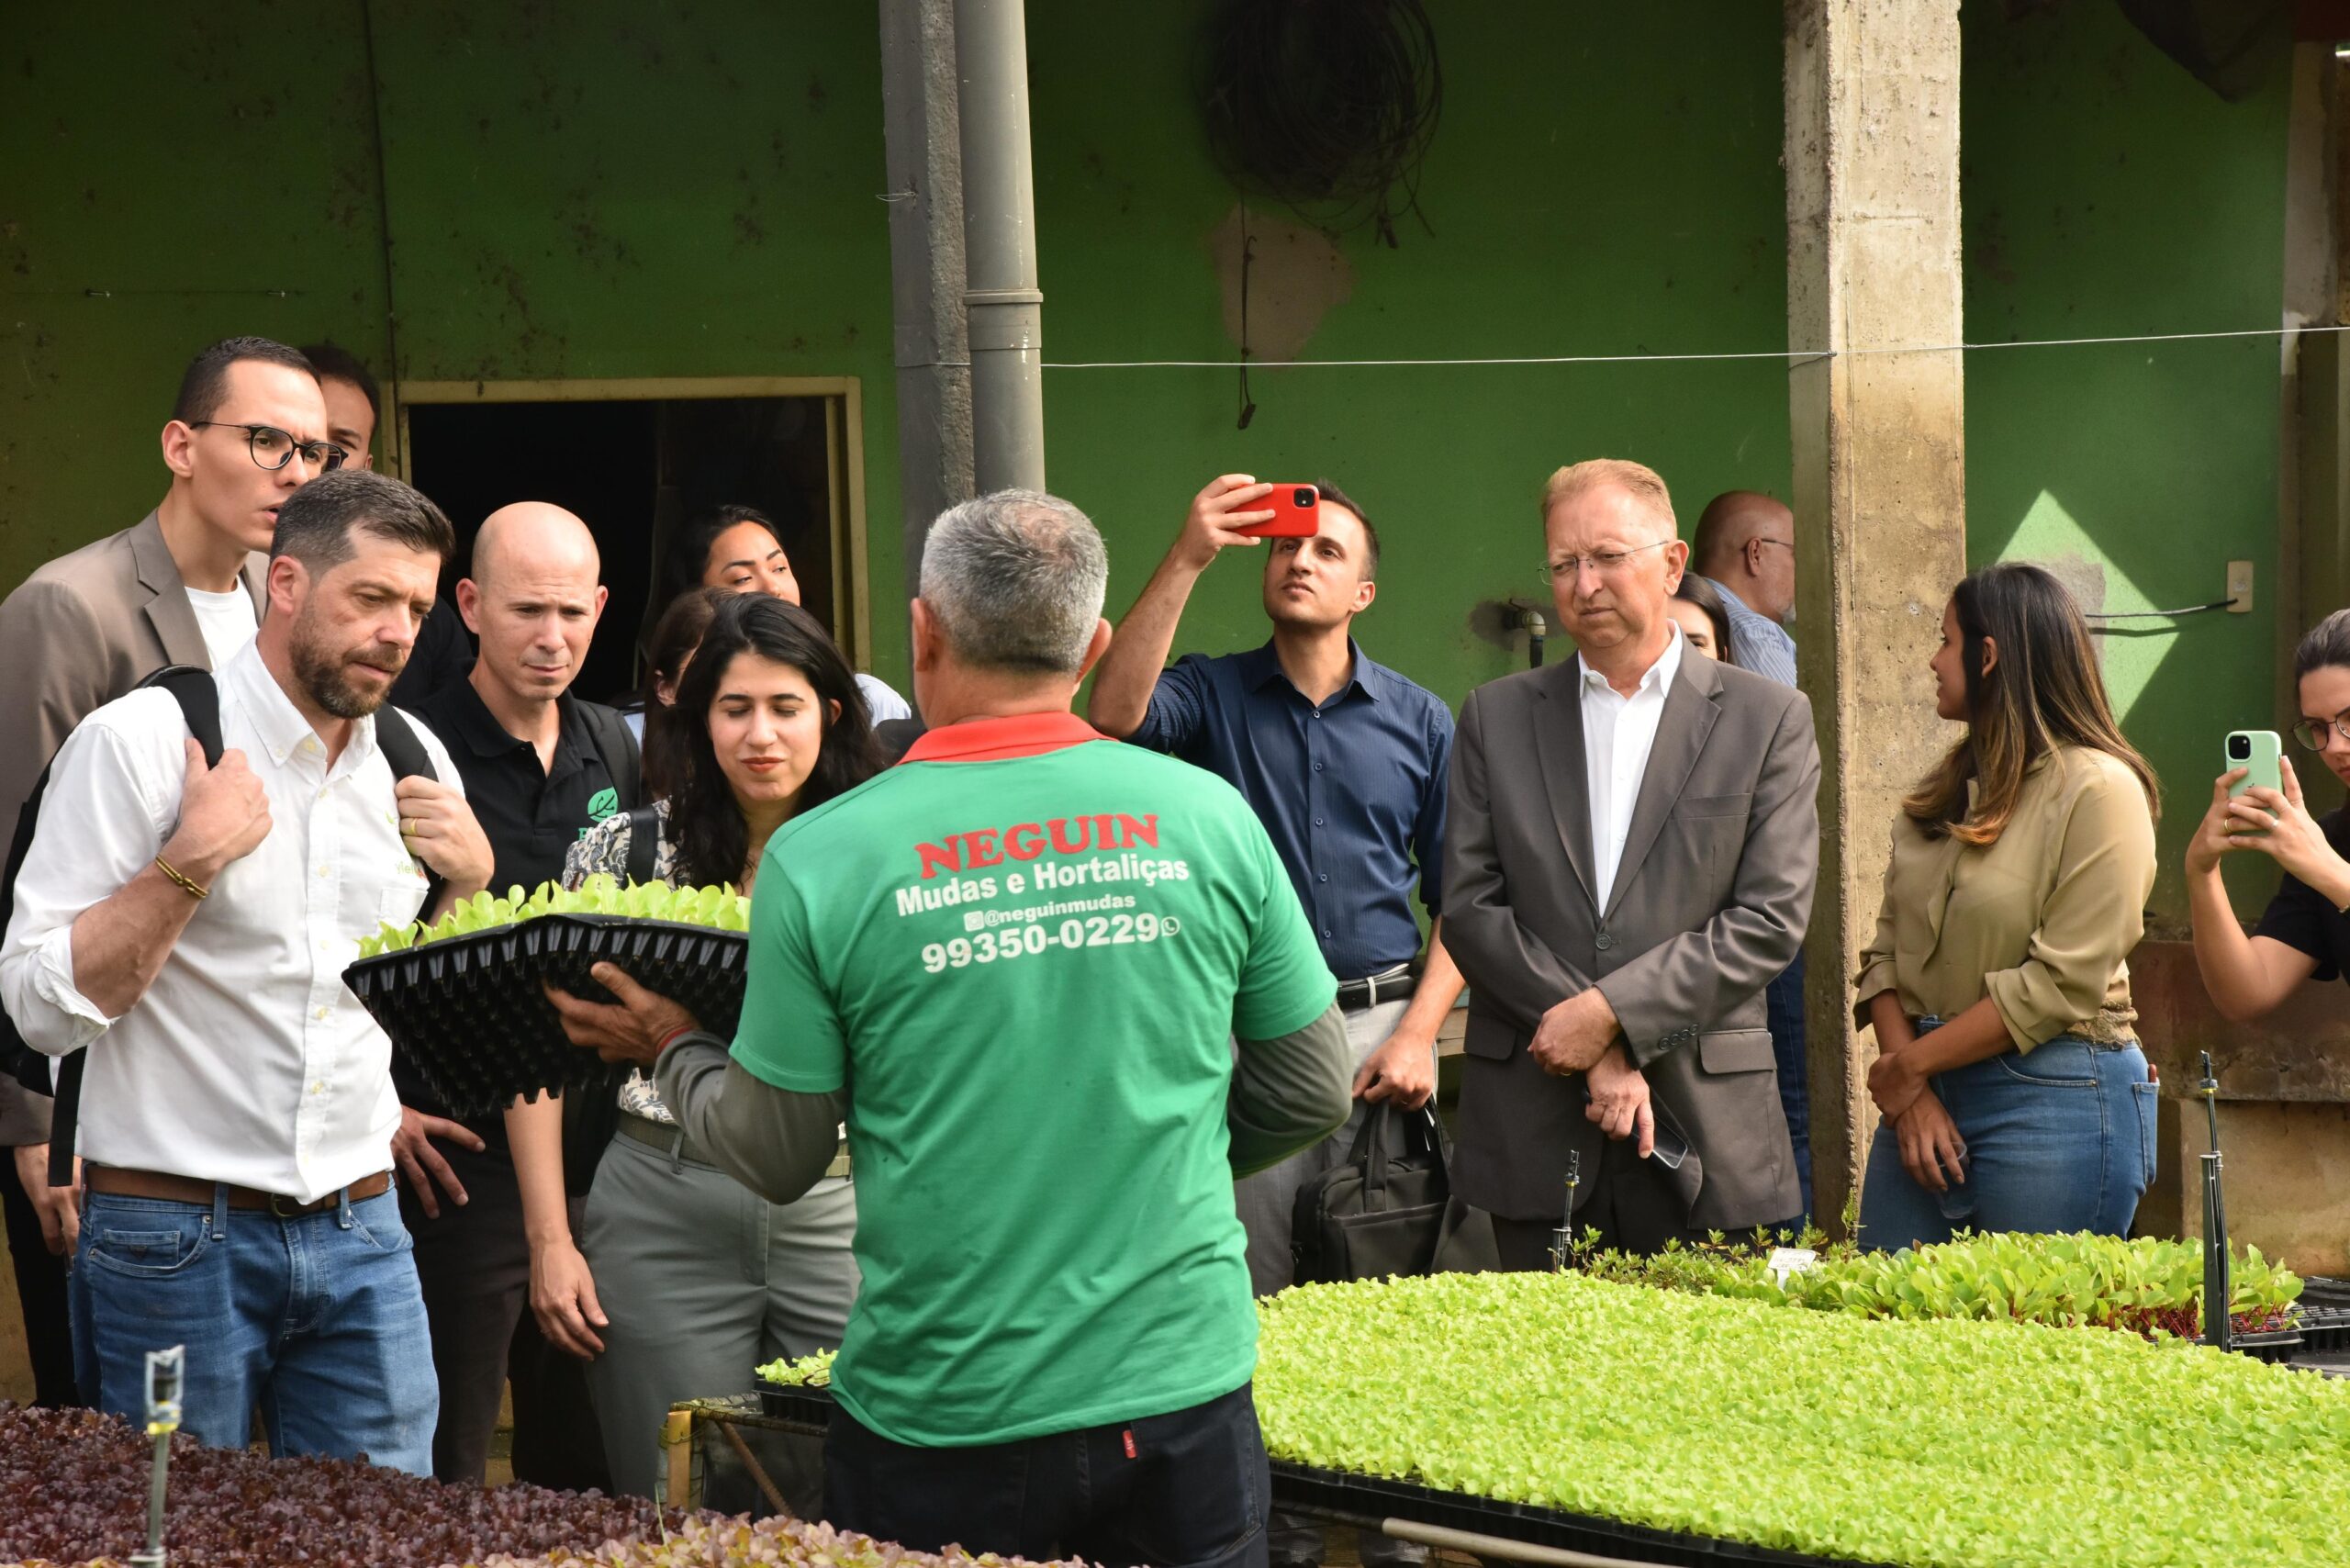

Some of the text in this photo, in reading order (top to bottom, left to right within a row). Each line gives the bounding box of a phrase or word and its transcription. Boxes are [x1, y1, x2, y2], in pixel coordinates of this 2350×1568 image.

[913, 813, 1158, 879] NEGUIN
[895, 853, 1190, 916] Mudas e Hortaliças
[984, 893, 1136, 926] @neguinmudas
[921, 913, 1159, 973] 99350-0229
